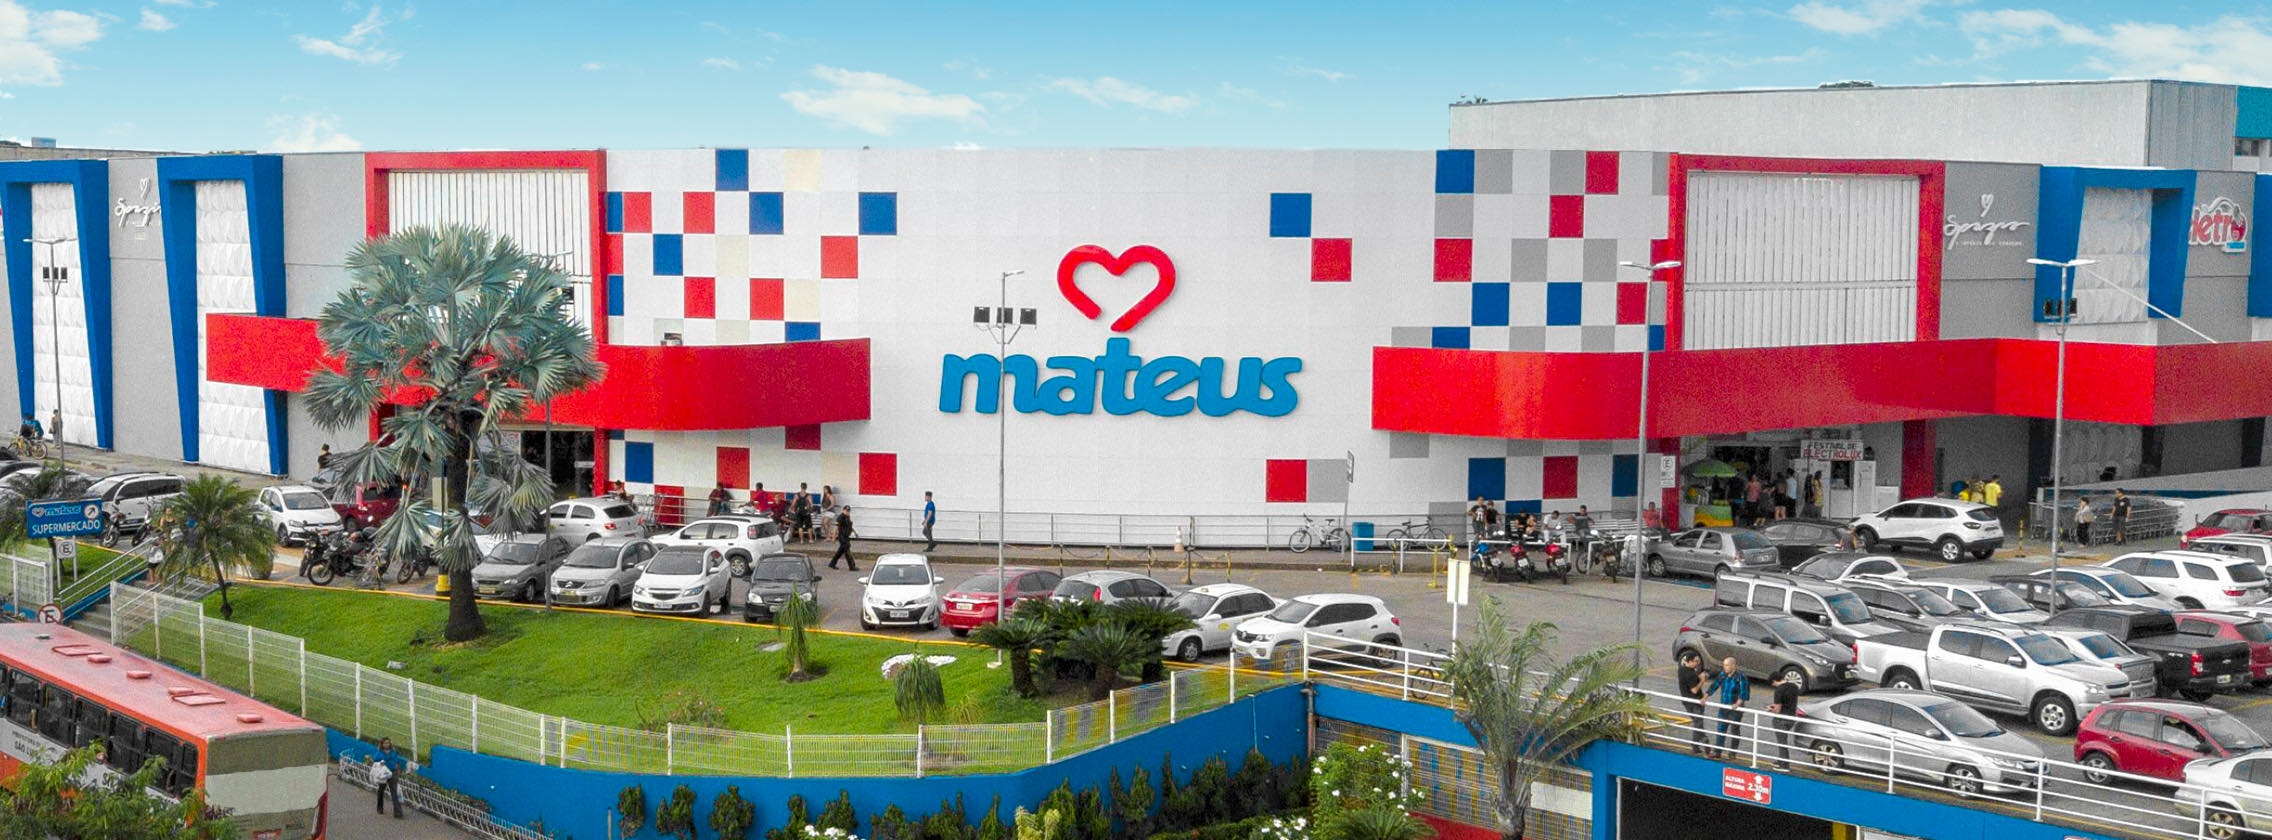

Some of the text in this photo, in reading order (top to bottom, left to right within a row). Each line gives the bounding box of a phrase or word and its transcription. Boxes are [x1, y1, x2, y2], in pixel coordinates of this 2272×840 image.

[1944, 214, 2031, 250] Spazio
[939, 337, 1302, 417] mateus
[1802, 447, 1862, 459] ELECTROLUX
[32, 520, 101, 535] SUPERMERCADO
